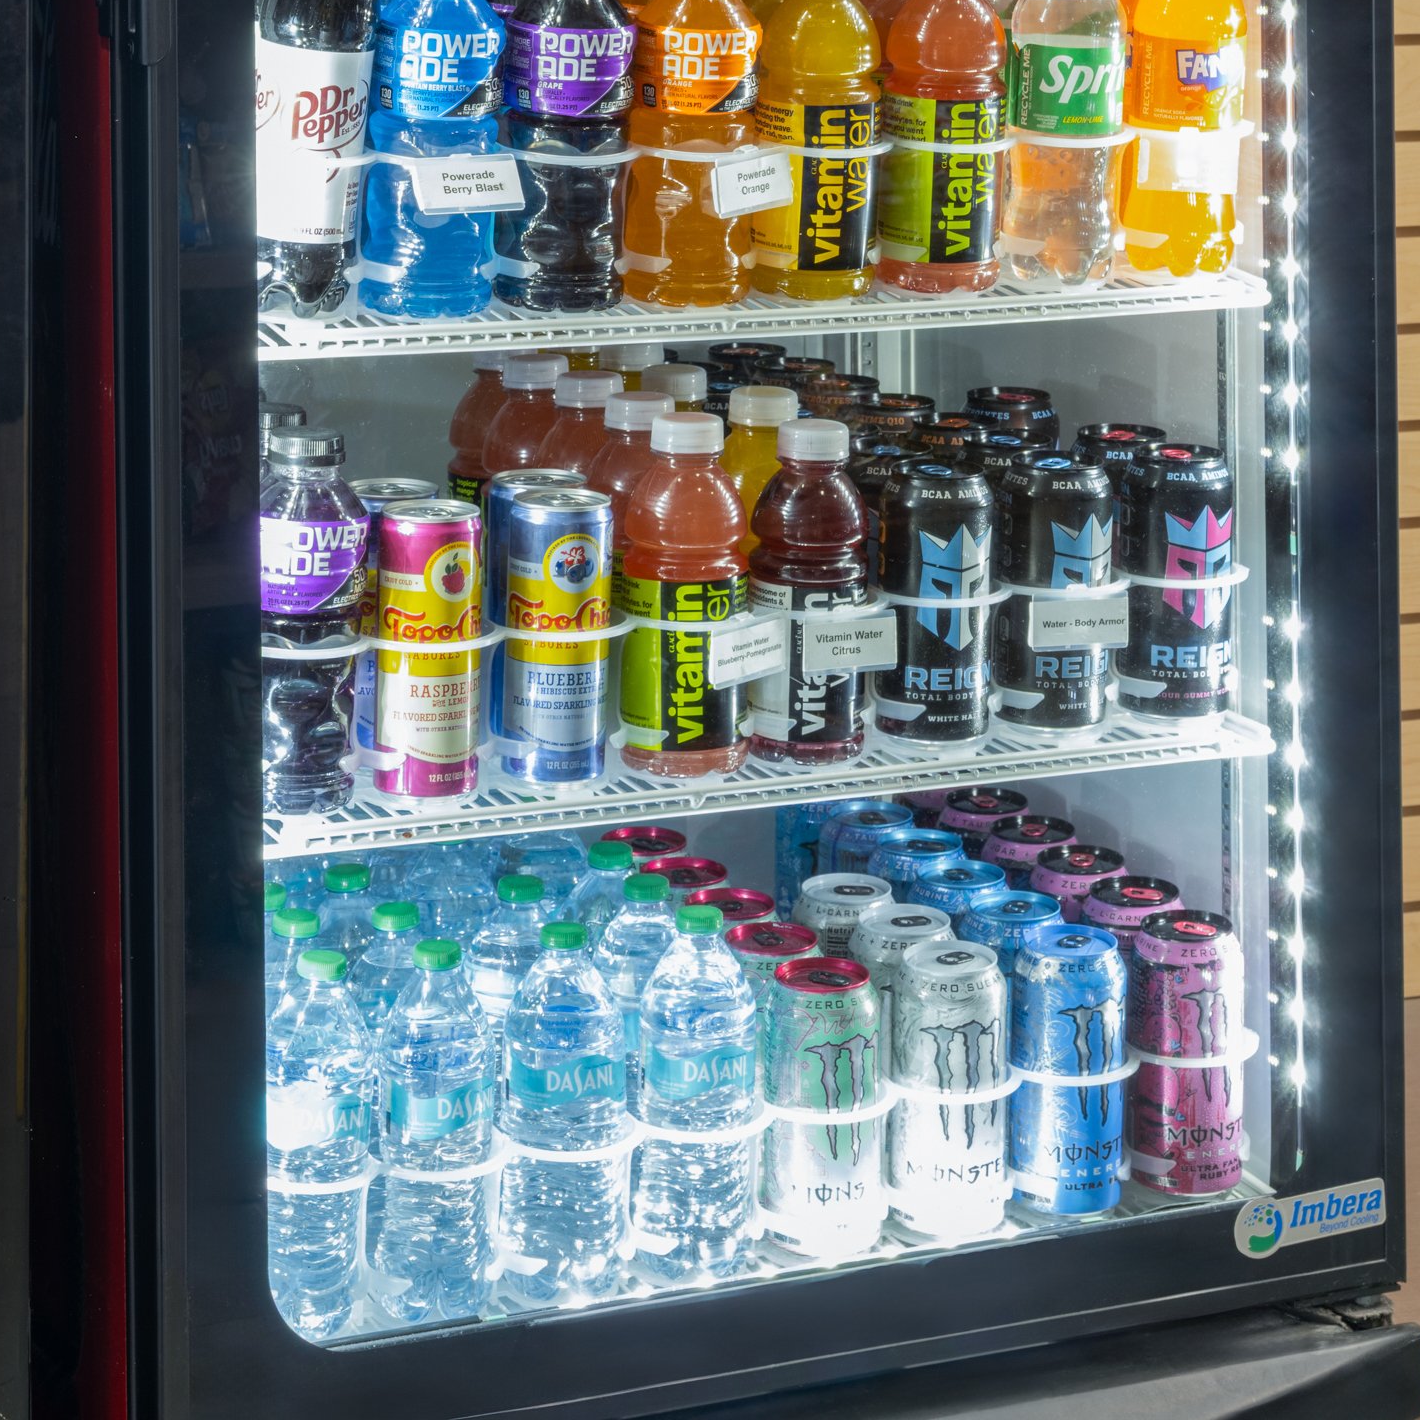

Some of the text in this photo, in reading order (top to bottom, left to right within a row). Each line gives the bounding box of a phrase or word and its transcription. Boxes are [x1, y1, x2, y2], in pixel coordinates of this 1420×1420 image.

[663, 31, 758, 55] POWER
[662, 57, 720, 79] ADE
[538, 81, 563, 90] GRAPE
[319, 85, 355, 114] Dr
[291, 90, 368, 148] Pepper
[441, 170, 495, 182] Powerade
[737, 166, 776, 182] Powerade
[443, 181, 504, 196] Berry Blast
[741, 181, 770, 196] Orange
[807, 109, 846, 264] vitamin
[921, 489, 952, 499] BCAA
[1042, 617, 1125, 629] Water Body Armor
[732, 636, 770, 653] Vitamin Water
[815, 630, 883, 644] Vitamin Water
[717, 643, 782, 667] Blueberry-Pomegranate
[831, 645, 862, 656] Citrus
[904, 659, 991, 691] REIGN
[546, 1064, 613, 1097] DASANI
[683, 1054, 748, 1086] DASANI
[1290, 1188, 1383, 1228] Imbera
[1319, 1213, 1380, 1234] Beyond Cooling
